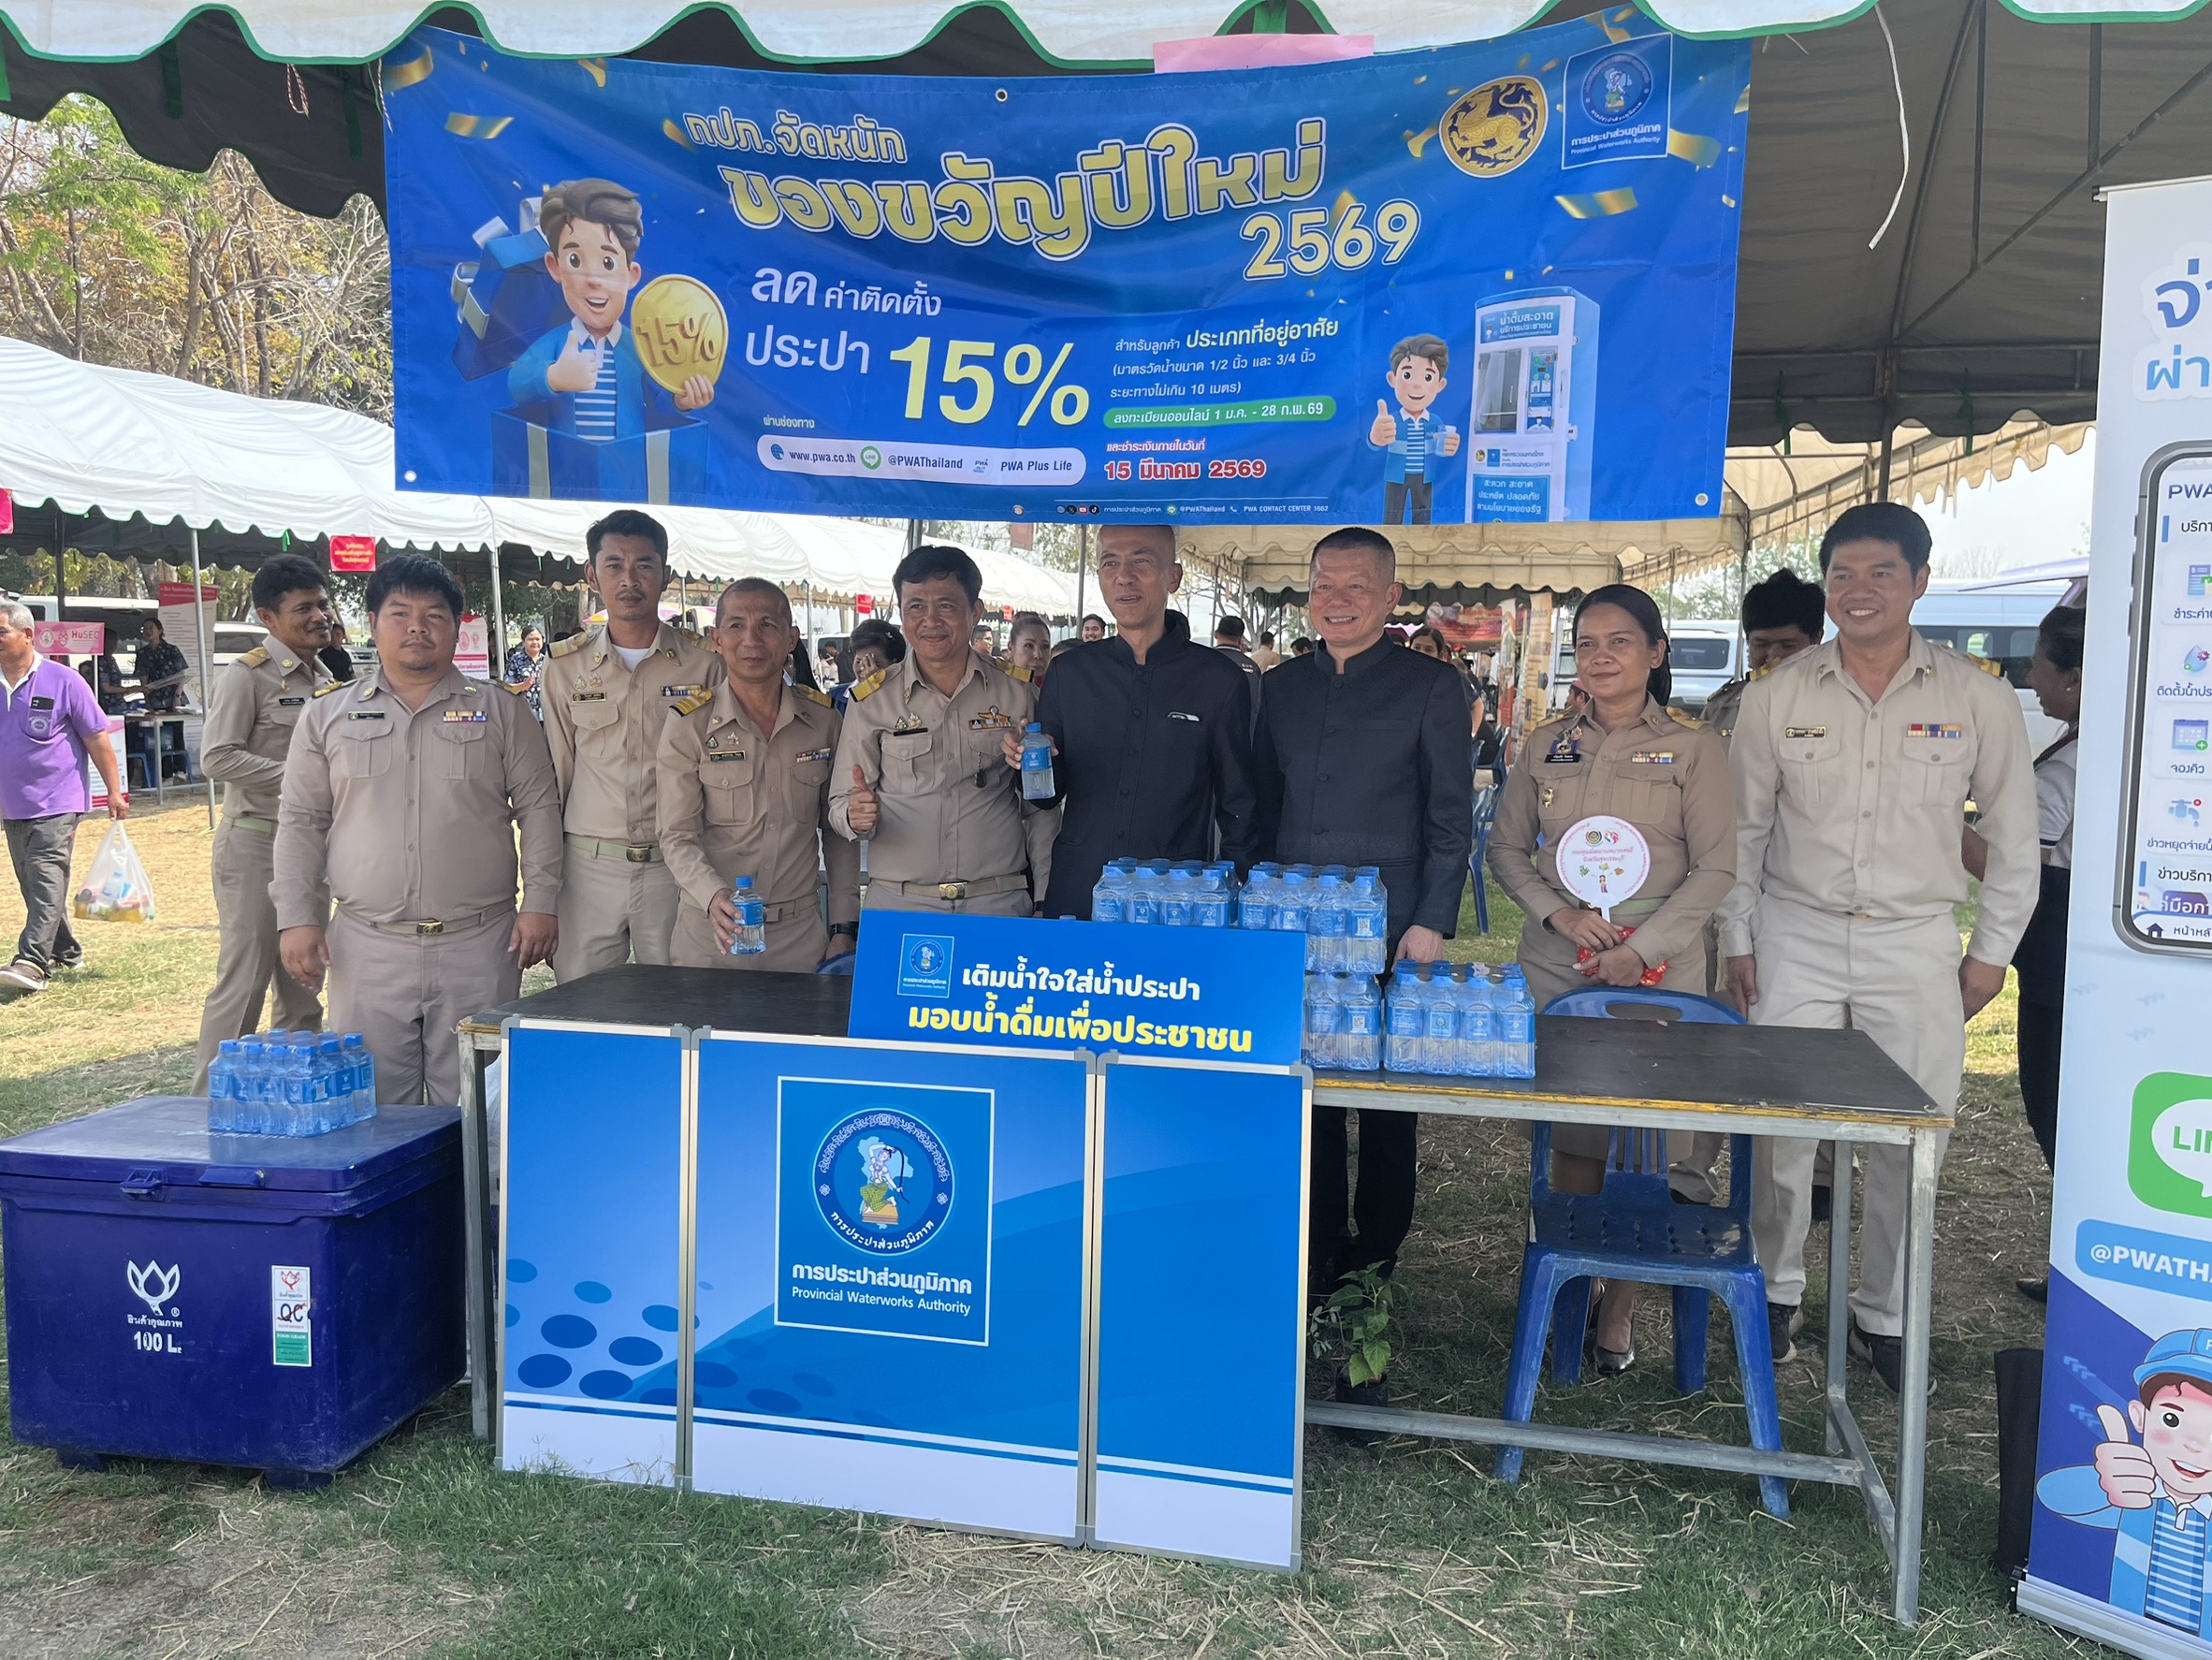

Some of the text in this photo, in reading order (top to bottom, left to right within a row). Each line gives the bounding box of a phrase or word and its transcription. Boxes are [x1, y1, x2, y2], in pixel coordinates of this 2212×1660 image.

[683, 106, 908, 164] กปภ.จัดหนัก
[1571, 124, 1662, 147] การประปาส่วนภูมิภาค
[1633, 135, 1661, 144] Authority
[717, 117, 1326, 262] ของขวัญปีใหม่
[1240, 197, 1420, 281] 2569
[751, 267, 941, 317] ลด ค่าติดตั้ง
[1499, 321, 1552, 334] บริการประชาชน
[1500, 311, 1553, 326] น้ำดื่มสะอาด
[636, 312, 719, 367] 15%
[1115, 317, 1339, 355] สำหรับลูกค้า ประเภทที่อยู่อาศัย
[746, 325, 870, 374] ประปา
[1113, 347, 1317, 376] (มาตรวัดน้ำขนาด 1/2 นิ้ว และ 3/4 นิ้ว
[890, 335, 1089, 428] 15%
[1110, 381, 1242, 399] ระยะทางไม่เกิน 10 เมตร)
[763, 415, 815, 430] ผ่านช่องทาง
[1113, 407, 1210, 425] ลงทะเบียนออนไลน์
[1214, 409, 1220, 420] 1
[1225, 407, 1247, 419] ม.ค.
[1260, 404, 1276, 417] 28
[1106, 437, 1206, 452] และชำระเงินภายในวันที่
[789, 450, 856, 464] www.pwa.co.th
[888, 455, 963, 470] @PWAThailand
[1000, 459, 1072, 472] PWA Plus Life
[1104, 457, 1267, 480] 15 มีนาคม 2569
[1508, 480, 1534, 488] สะอาด
[1180, 504, 1226, 513] @PWAThailand
[1244, 504, 1258, 513] PWA
[1259, 504, 1287, 513] CONTACT
[2170, 763, 2205, 774] จองคิว
[962, 954, 1201, 1002] เติมน้ำใจใส่น้ำประปา
[909, 992, 1252, 1053] มอบน้ำดื่มเพื่อประชาชน
[830, 1211, 935, 1250] การประปาส่วนภูมิภาค
[792, 1263, 972, 1294] การประปาส่วนภูมิภาค
[281, 1303, 304, 1323] QC
[792, 1287, 971, 1317] Provincial Waterworks Authority
[127, 1314, 183, 1329] สินค้าคุณภาพ
[133, 1331, 163, 1353] 100
